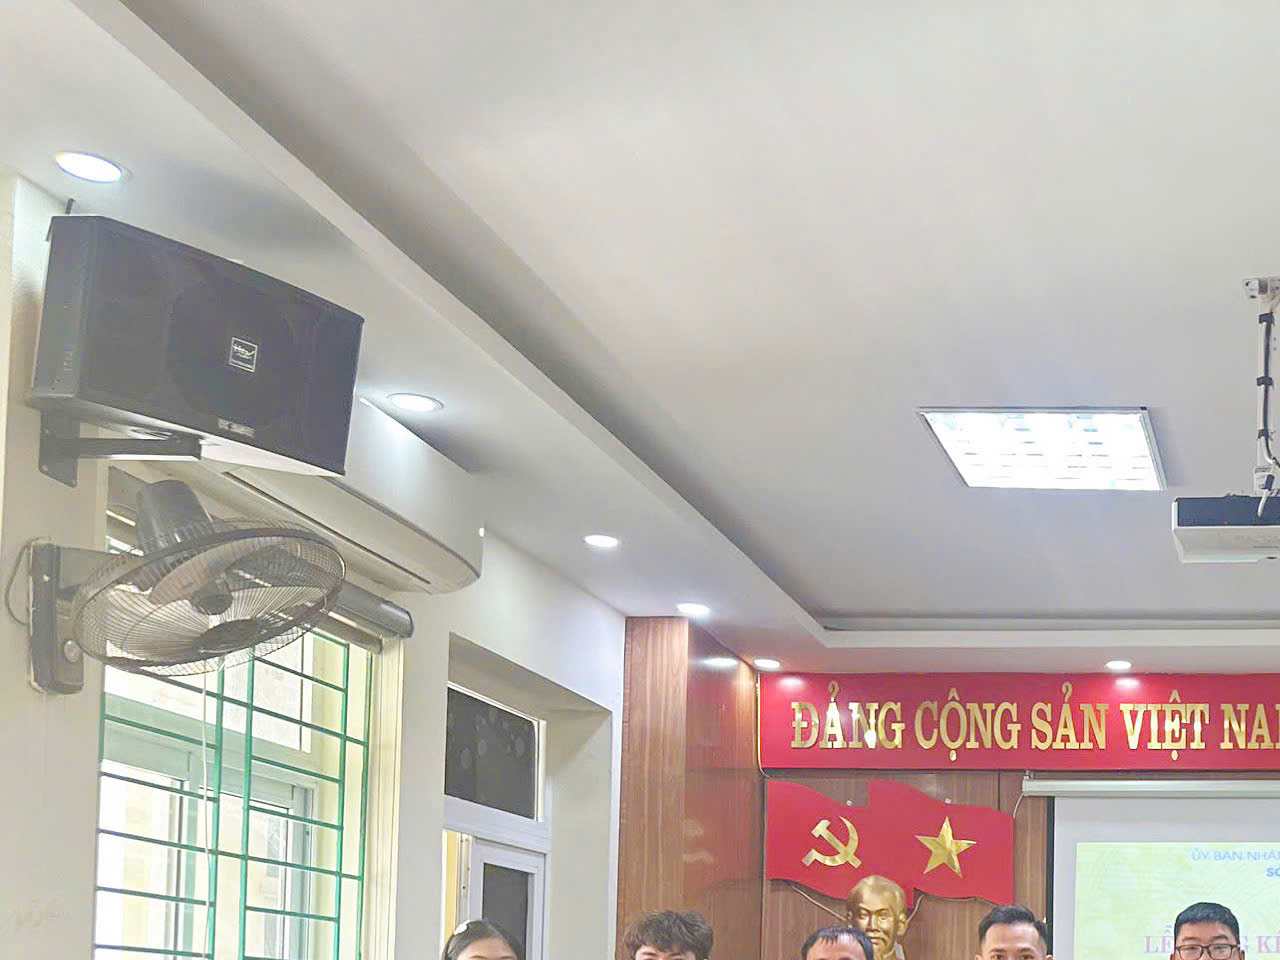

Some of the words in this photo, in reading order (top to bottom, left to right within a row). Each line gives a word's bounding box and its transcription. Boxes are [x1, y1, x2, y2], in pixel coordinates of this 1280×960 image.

[790, 682, 905, 750] ĐẢNG
[914, 687, 1022, 762] CỘNG
[1030, 681, 1108, 751] SẢN
[1119, 689, 1211, 762] VIỆT
[1214, 851, 1242, 861] BAN
